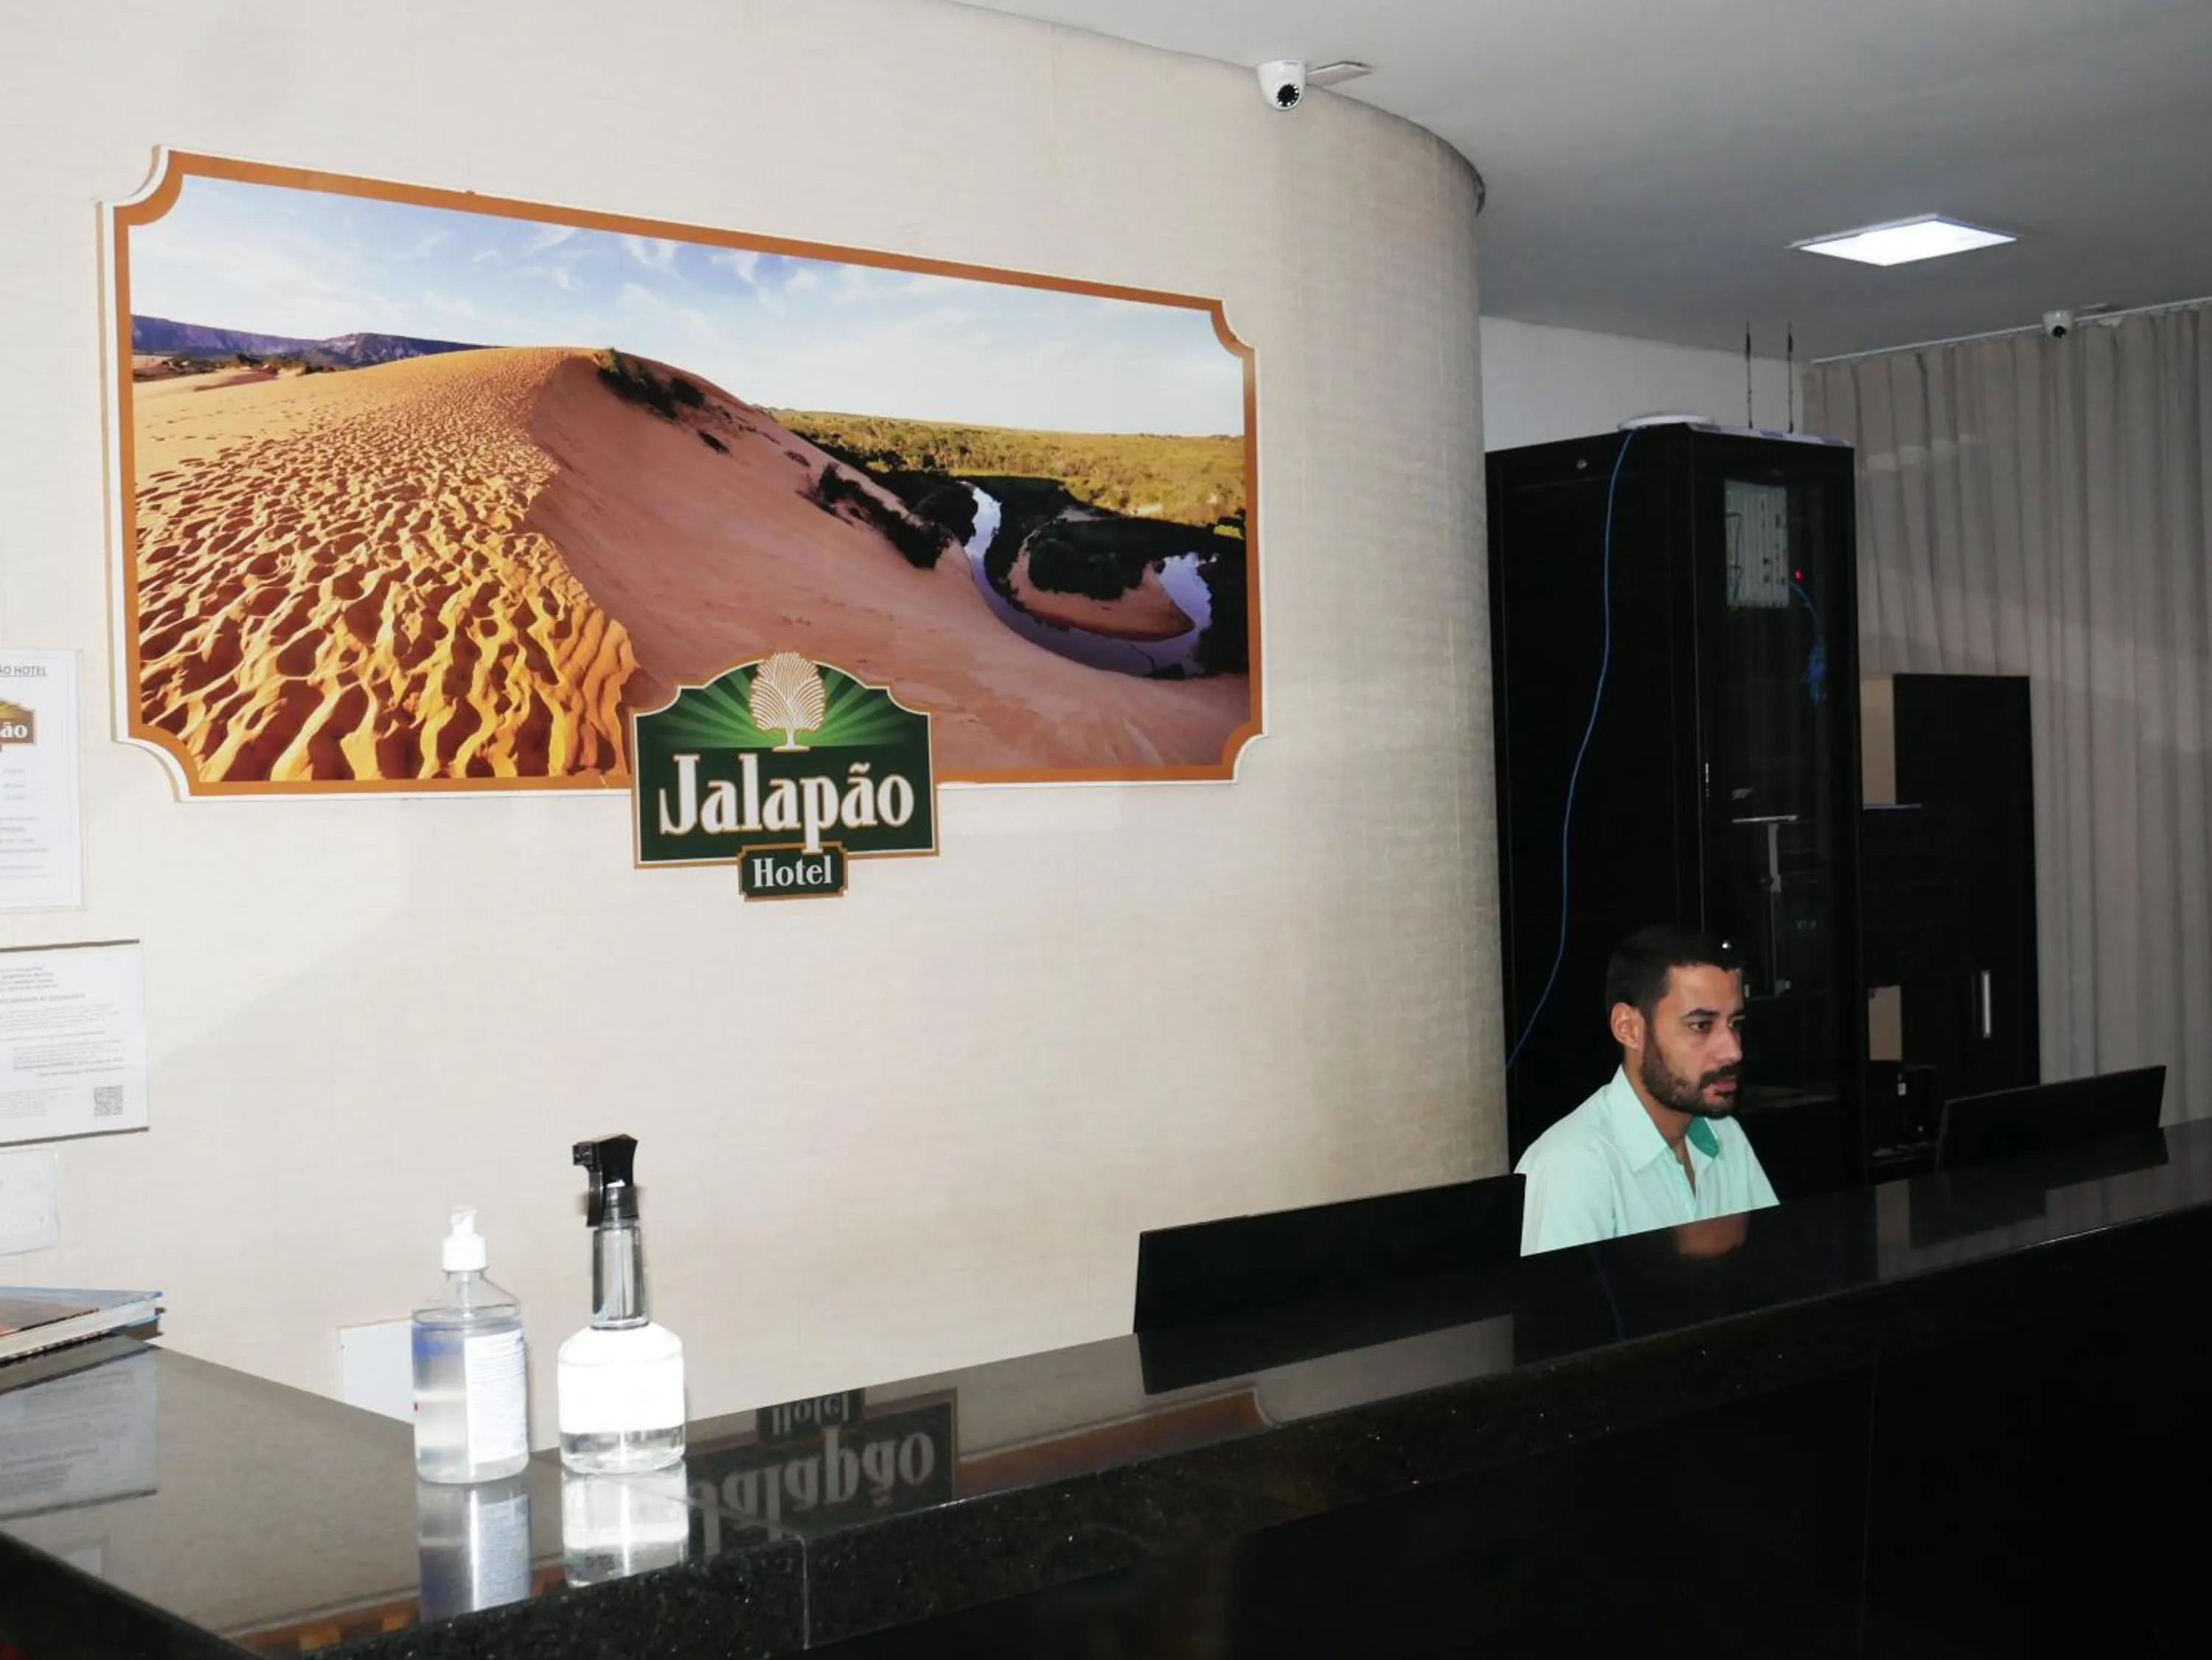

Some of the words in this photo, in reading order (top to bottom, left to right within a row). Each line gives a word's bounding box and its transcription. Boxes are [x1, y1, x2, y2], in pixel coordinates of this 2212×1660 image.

[14, 665, 48, 677] HOTEL
[658, 753, 914, 854] Jalapão
[752, 855, 833, 888] Hotel
